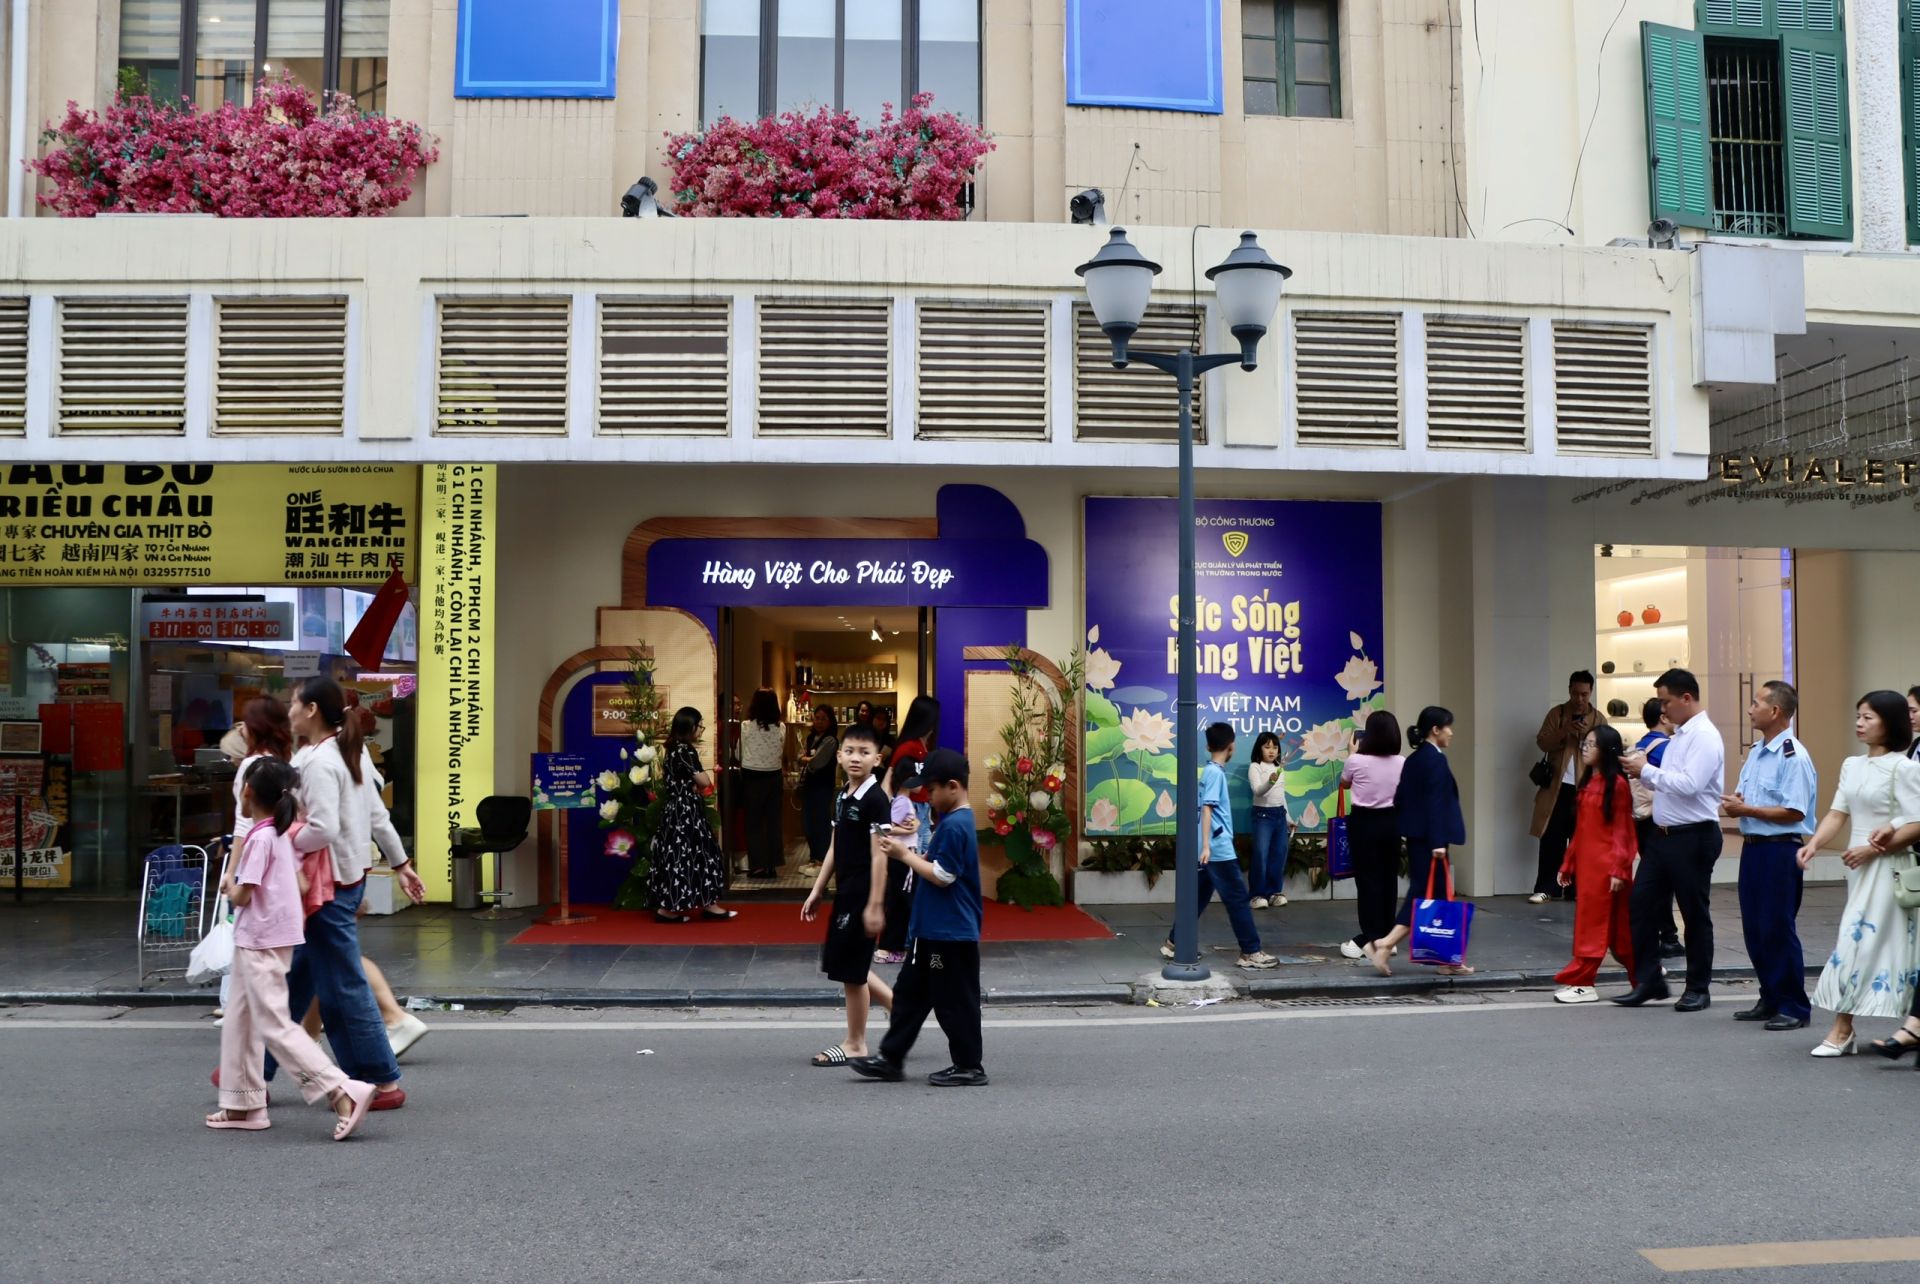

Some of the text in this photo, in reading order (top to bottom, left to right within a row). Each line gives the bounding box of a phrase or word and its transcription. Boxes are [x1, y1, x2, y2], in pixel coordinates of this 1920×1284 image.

[471, 466, 483, 474] 1
[1708, 454, 1917, 485] EVIALET
[102, 482, 213, 517] CHÂU
[286, 489, 322, 505] ONE
[470, 478, 483, 505] CHI
[1838, 492, 1850, 501] DE
[452, 493, 464, 519] CHI
[285, 502, 406, 535] 旺和牛
[1195, 516, 1275, 527] BỘ CÔNG THƯƠNG
[41, 521, 212, 542] CHUYÊN GIA THỊT BÒ
[61, 543, 140, 562] 越南四家
[145, 544, 158, 552] TQ
[144, 568, 211, 577] 0329577510
[341, 571, 363, 579] BEEF
[702, 560, 955, 590] Hàng Việt Cho Phái Đẹp
[1245, 561, 1262, 569] PHÁT
[450, 590, 466, 623] CÒN
[468, 575, 481, 630] TPHCM
[1231, 589, 1300, 639] Sống
[468, 635, 480, 644] 2
[468, 648, 480, 675] CHI
[1247, 636, 1303, 679] Việt
[449, 688, 466, 706] LÀ
[1209, 691, 1252, 715] VIỆT
[1255, 696, 1301, 712] NAM
[1227, 715, 1255, 737] TỰ
[1258, 714, 1303, 733] HÀO
[448, 773, 464, 807] NHÀ
[448, 811, 460, 840] SA
